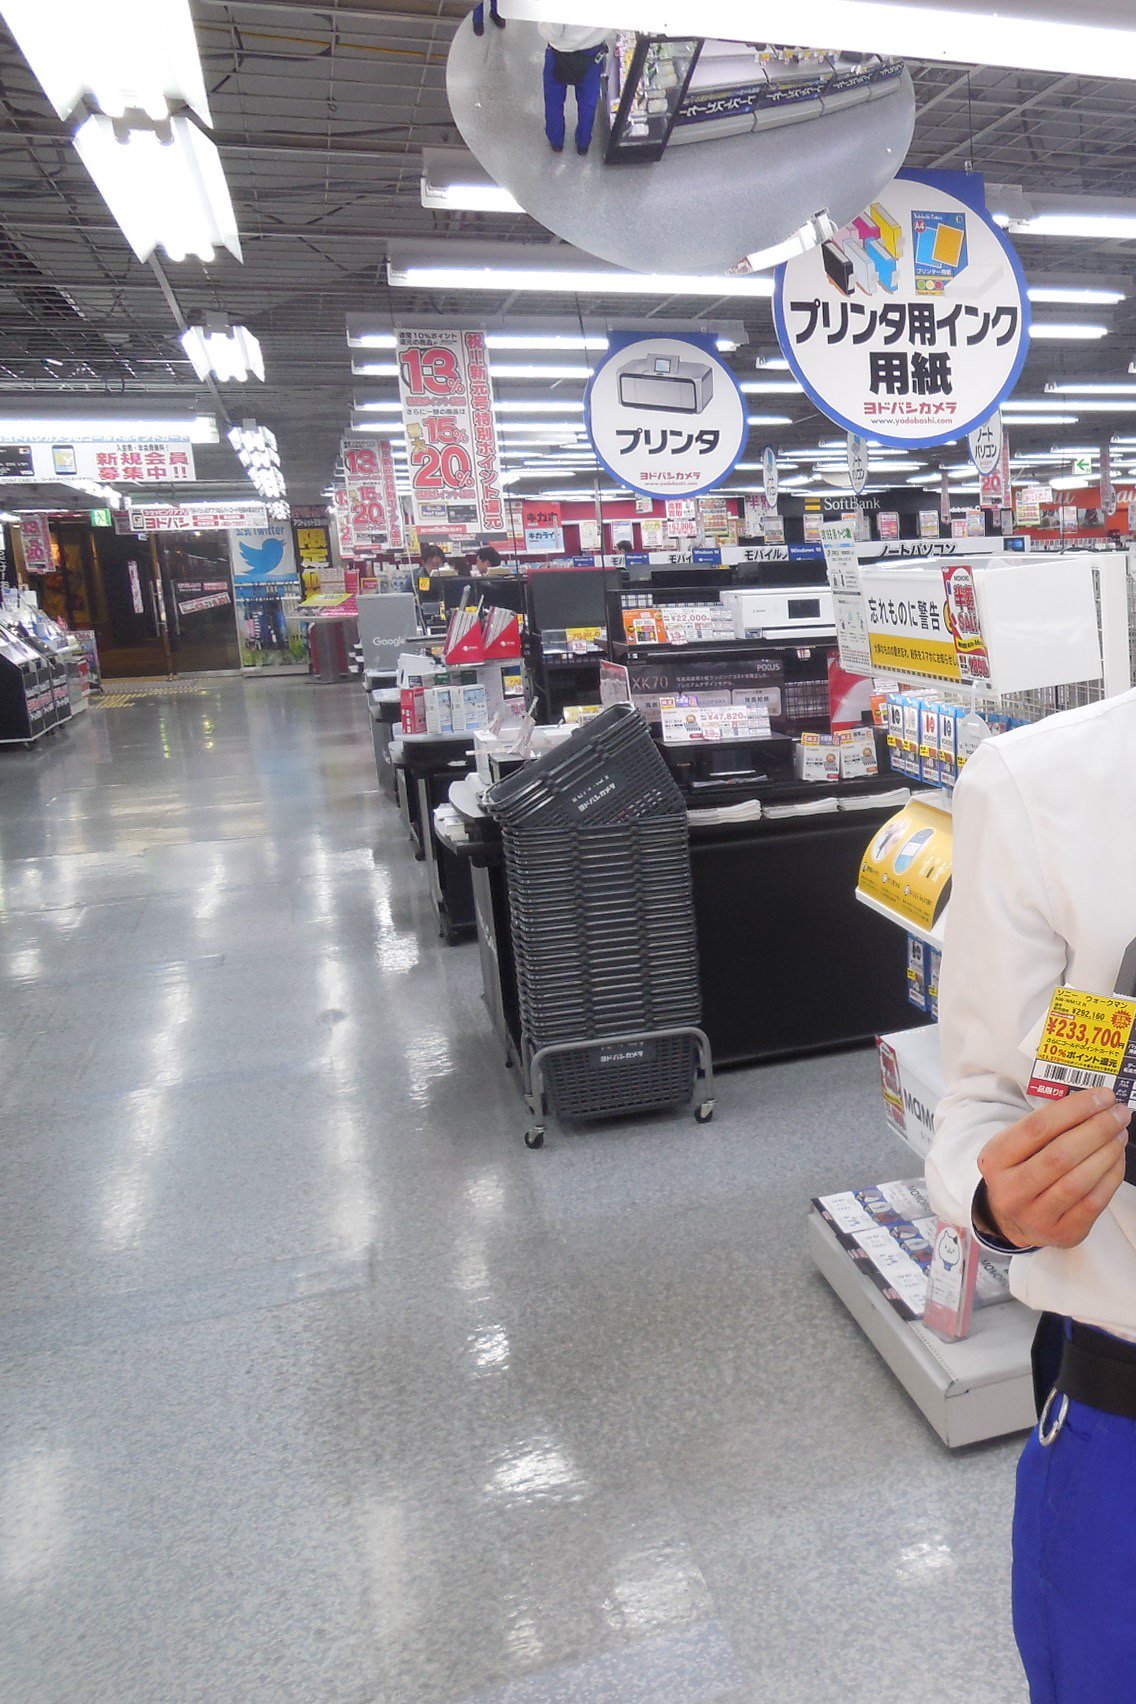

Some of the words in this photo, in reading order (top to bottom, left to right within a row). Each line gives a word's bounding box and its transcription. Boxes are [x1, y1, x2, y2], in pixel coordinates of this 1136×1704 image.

[790, 299, 1018, 347] プリンタ用インク
[400, 347, 466, 395] 13%
[869, 352, 952, 395] 用紙
[863, 402, 957, 415] ヨドバシカメラ
[871, 416, 953, 426] www.yodobashi.com
[423, 416, 470, 444] 15%
[616, 428, 720, 456] プリンタ
[96, 452, 189, 466] 新規会員
[974, 445, 997, 459] パソコン
[413, 444, 475, 489] 20%
[640, 471, 700, 481] ヨドバシカメラ
[824, 497, 881, 511] SoftBank
[145, 517, 189, 529] ヨドバシ
[529, 532, 554, 540] キカライ
[878, 542, 957, 557] ノートパソコン
[868, 598, 940, 632] 忘れものに警告
[1058, 989, 1078, 998] ソニー
[1085, 995, 1128, 1009] ウォークマン
[1072, 1007, 1105, 1020] ¥292,160
[1043, 1043, 1118, 1068] 10%ポイント還元
